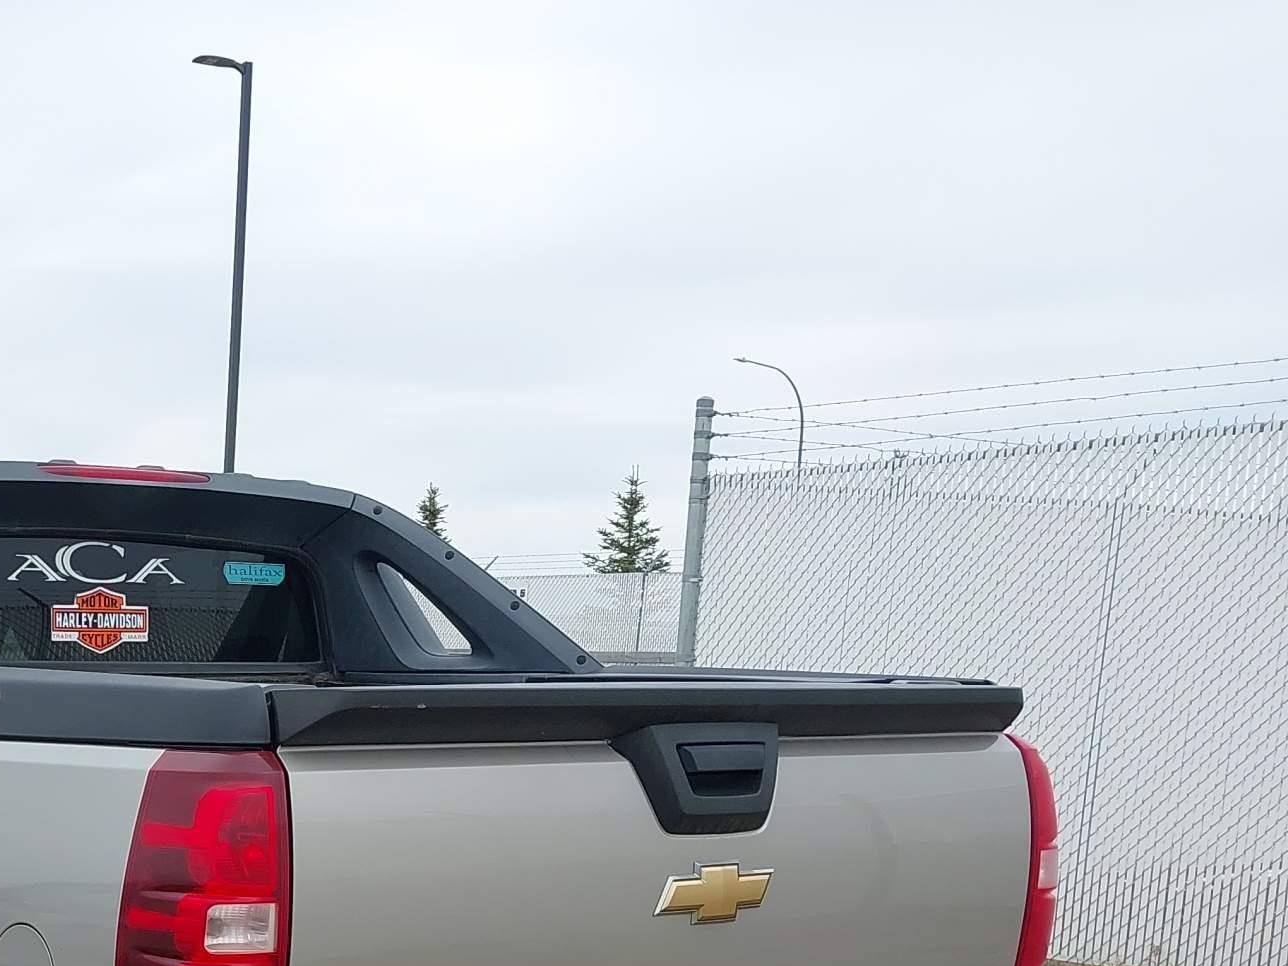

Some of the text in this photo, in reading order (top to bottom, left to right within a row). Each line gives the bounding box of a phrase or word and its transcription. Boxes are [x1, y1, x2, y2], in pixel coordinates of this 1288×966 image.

[7, 541, 185, 584] ACA
[228, 565, 282, 577] halifax
[81, 593, 118, 608] MOTOR
[55, 612, 144, 629] HARLEY-DAVIDSON
[82, 633, 119, 648] CYCLES
